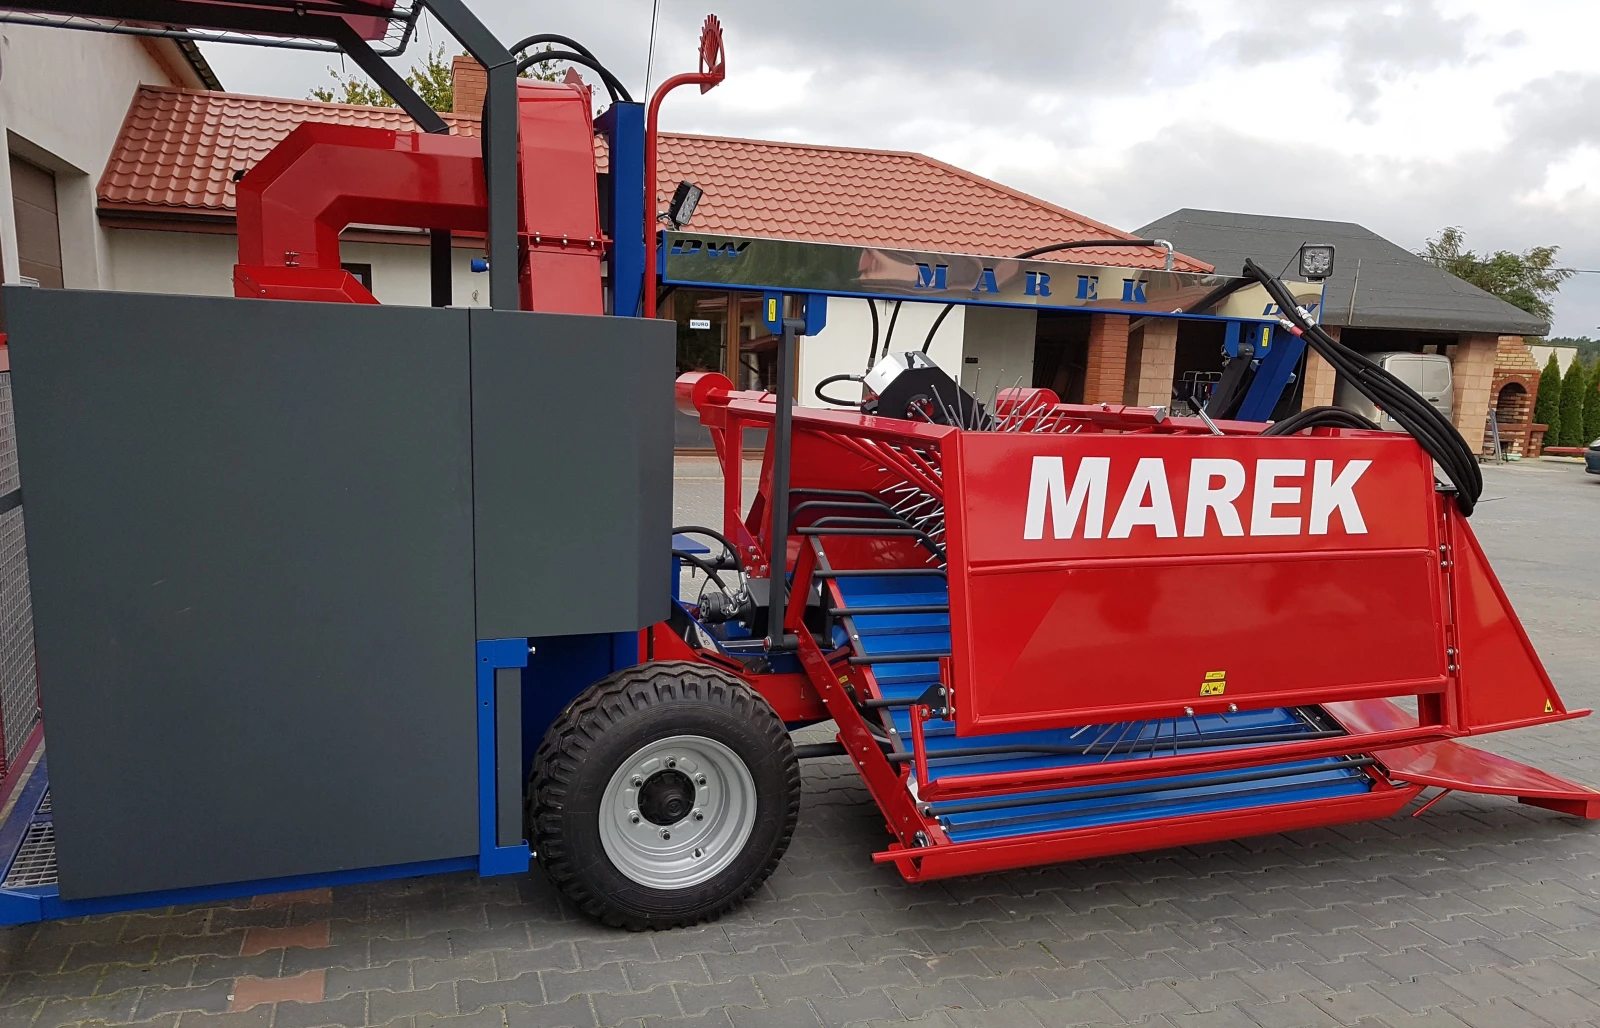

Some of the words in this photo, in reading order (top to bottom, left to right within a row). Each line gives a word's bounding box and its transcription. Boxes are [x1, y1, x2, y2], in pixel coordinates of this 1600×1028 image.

[670, 239, 752, 257] DW
[913, 262, 1149, 303] MAREK
[1023, 456, 1373, 540] MAREK
